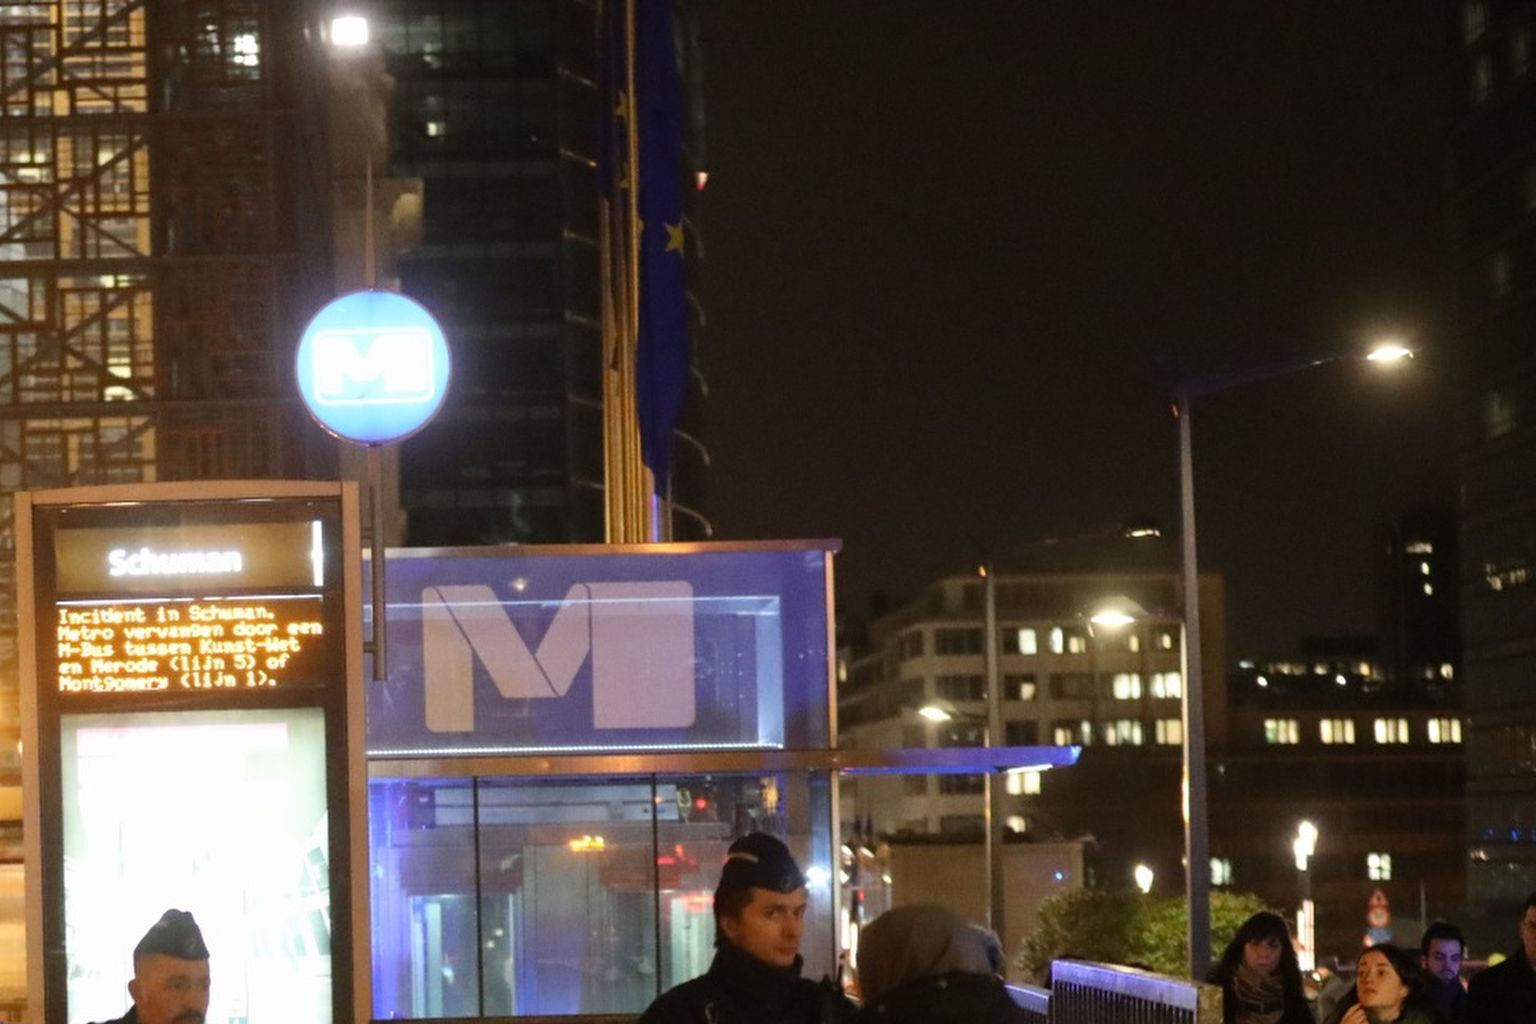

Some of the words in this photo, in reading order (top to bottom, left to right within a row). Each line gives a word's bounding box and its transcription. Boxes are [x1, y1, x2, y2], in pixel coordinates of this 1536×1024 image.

[318, 330, 430, 396] M
[108, 546, 243, 576] Schuman
[59, 607, 146, 624] Incident
[157, 606, 180, 622] in
[189, 604, 275, 621] Schuman.
[58, 625, 114, 641] Metro
[123, 623, 224, 639] vervangen
[233, 620, 278, 636] door
[287, 622, 323, 635] een
[58, 641, 114, 658] M-Bus
[124, 640, 191, 656] tussen
[200, 636, 301, 654] Kunst-Wet
[421, 580, 697, 733] M
[59, 662, 83, 674] en
[91, 657, 159, 674] Merode
[170, 654, 225, 672] (lijn
[233, 653, 256, 670] 5)
[266, 652, 290, 669] of
[59, 675, 169, 692] Montgomery
[180, 671, 236, 688] (lijn
